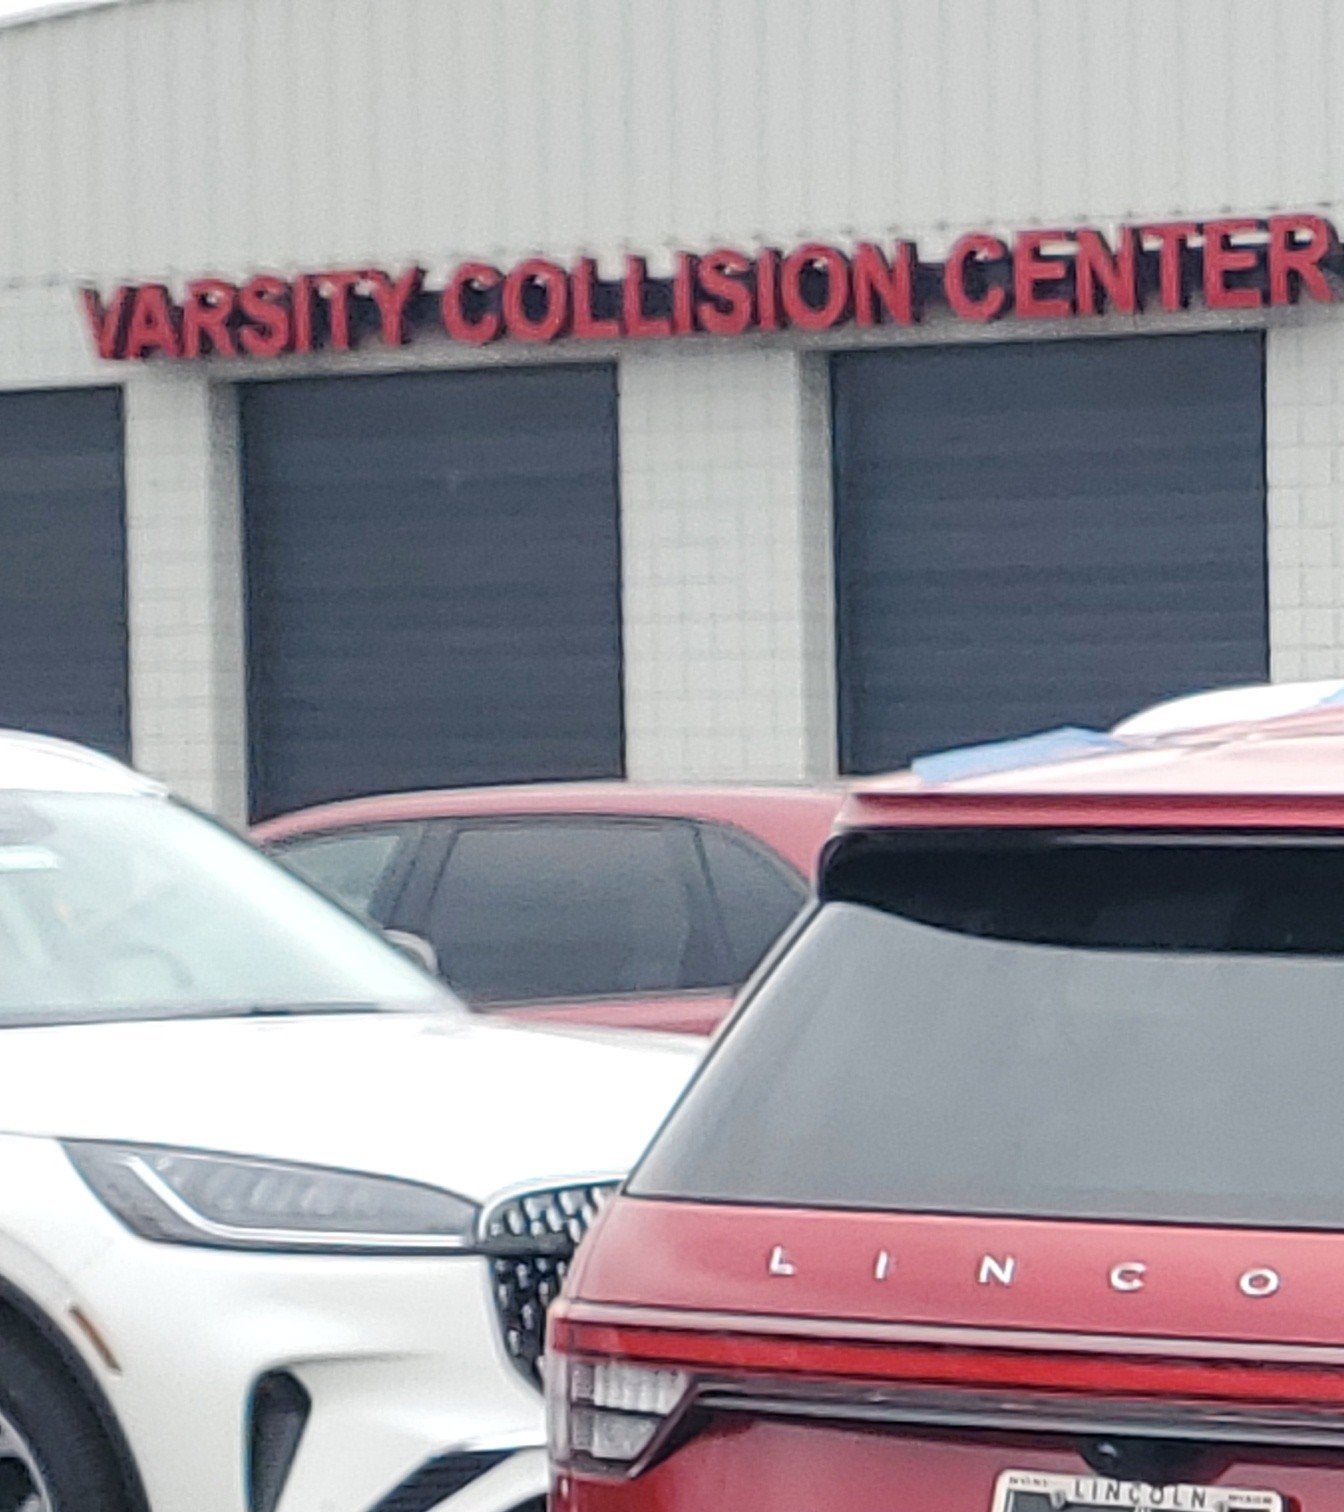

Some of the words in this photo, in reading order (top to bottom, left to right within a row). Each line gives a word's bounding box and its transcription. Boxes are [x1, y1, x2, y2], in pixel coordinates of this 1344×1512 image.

[82, 266, 422, 359] VARSITY
[442, 240, 918, 346] COLLISION
[943, 213, 1335, 322] CENTER
[1073, 1478, 1207, 1507] LINCOLN
